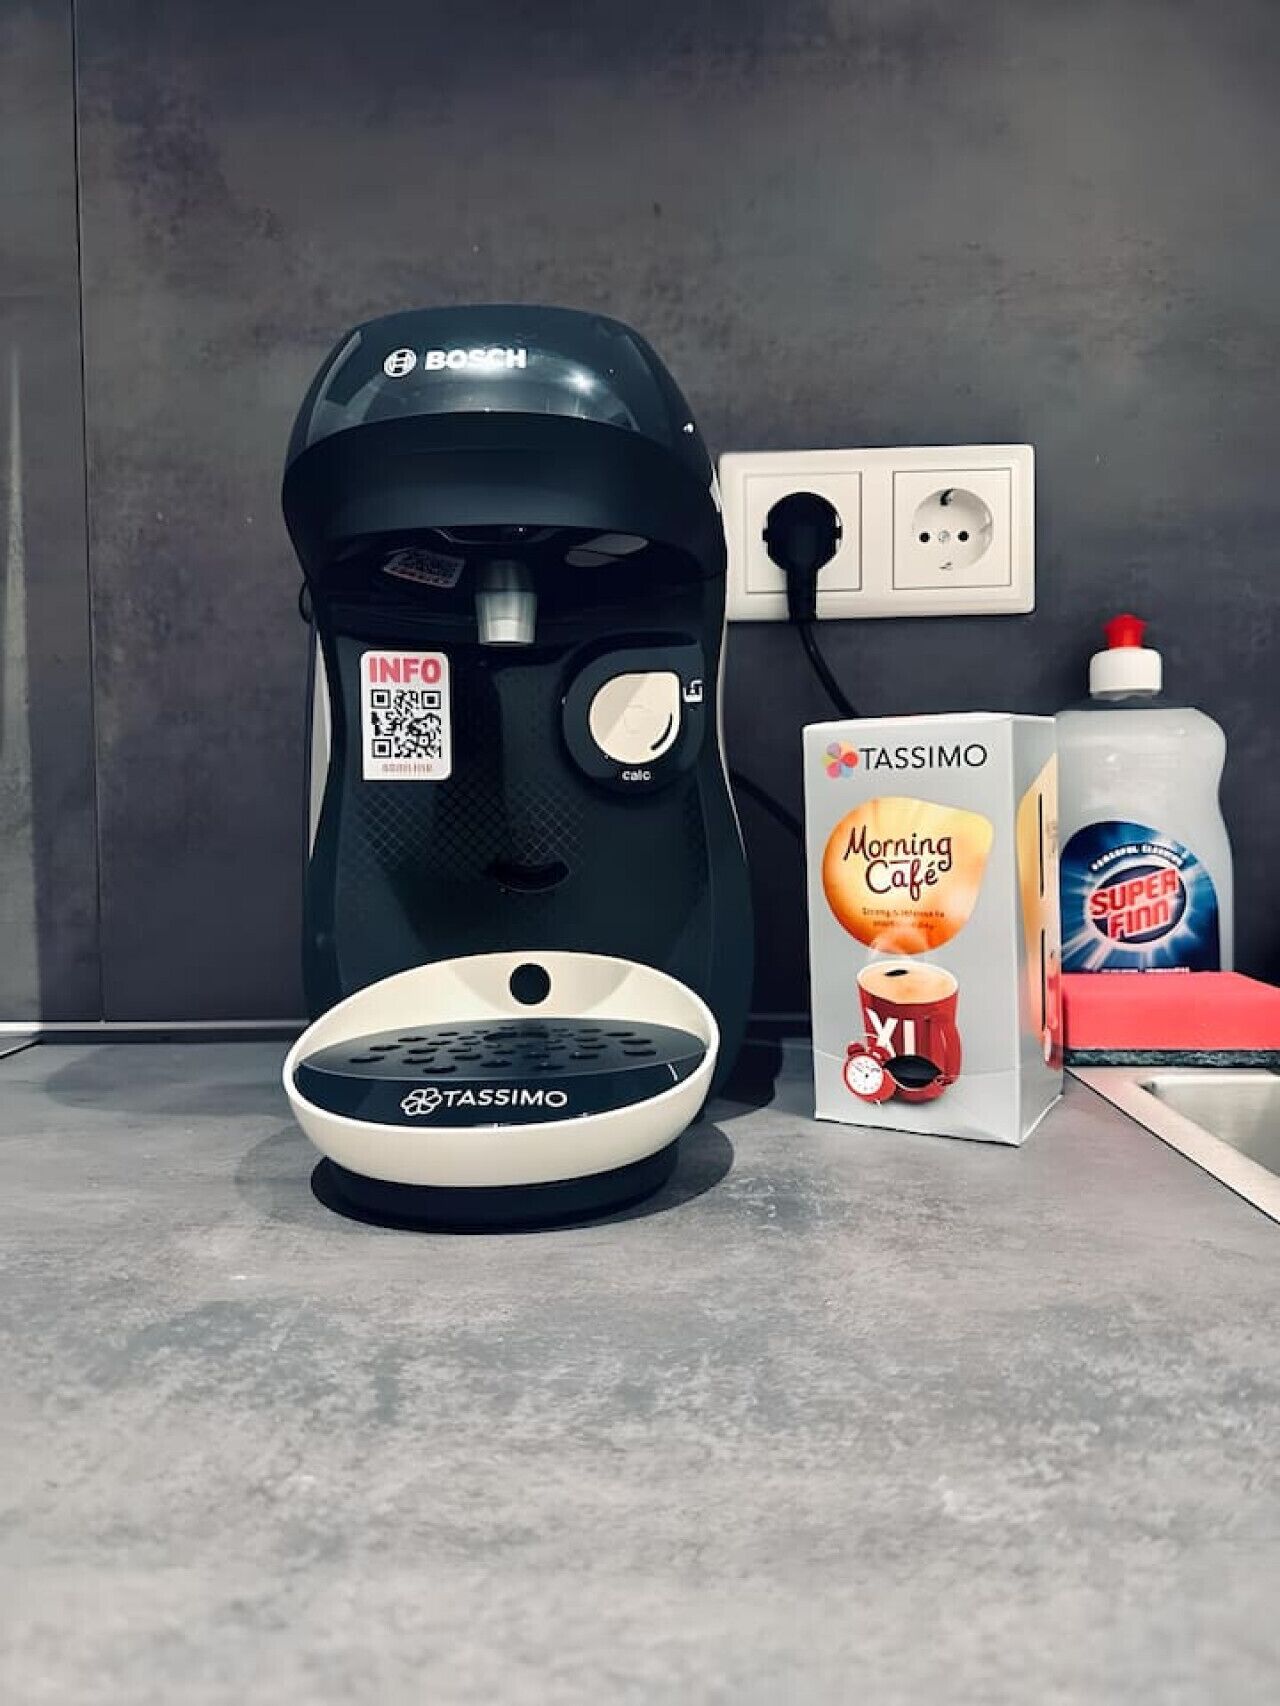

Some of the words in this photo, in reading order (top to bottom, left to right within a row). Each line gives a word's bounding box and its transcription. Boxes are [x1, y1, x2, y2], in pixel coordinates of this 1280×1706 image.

[424, 348, 527, 371] BOSCH
[369, 657, 442, 684] INFO
[858, 743, 988, 771] TASSIMO
[621, 769, 651, 781] calc
[843, 824, 953, 872] Morning
[865, 859, 939, 901] Café
[1090, 868, 1177, 917] SUPER
[443, 1088, 568, 1108] TASSIMO
